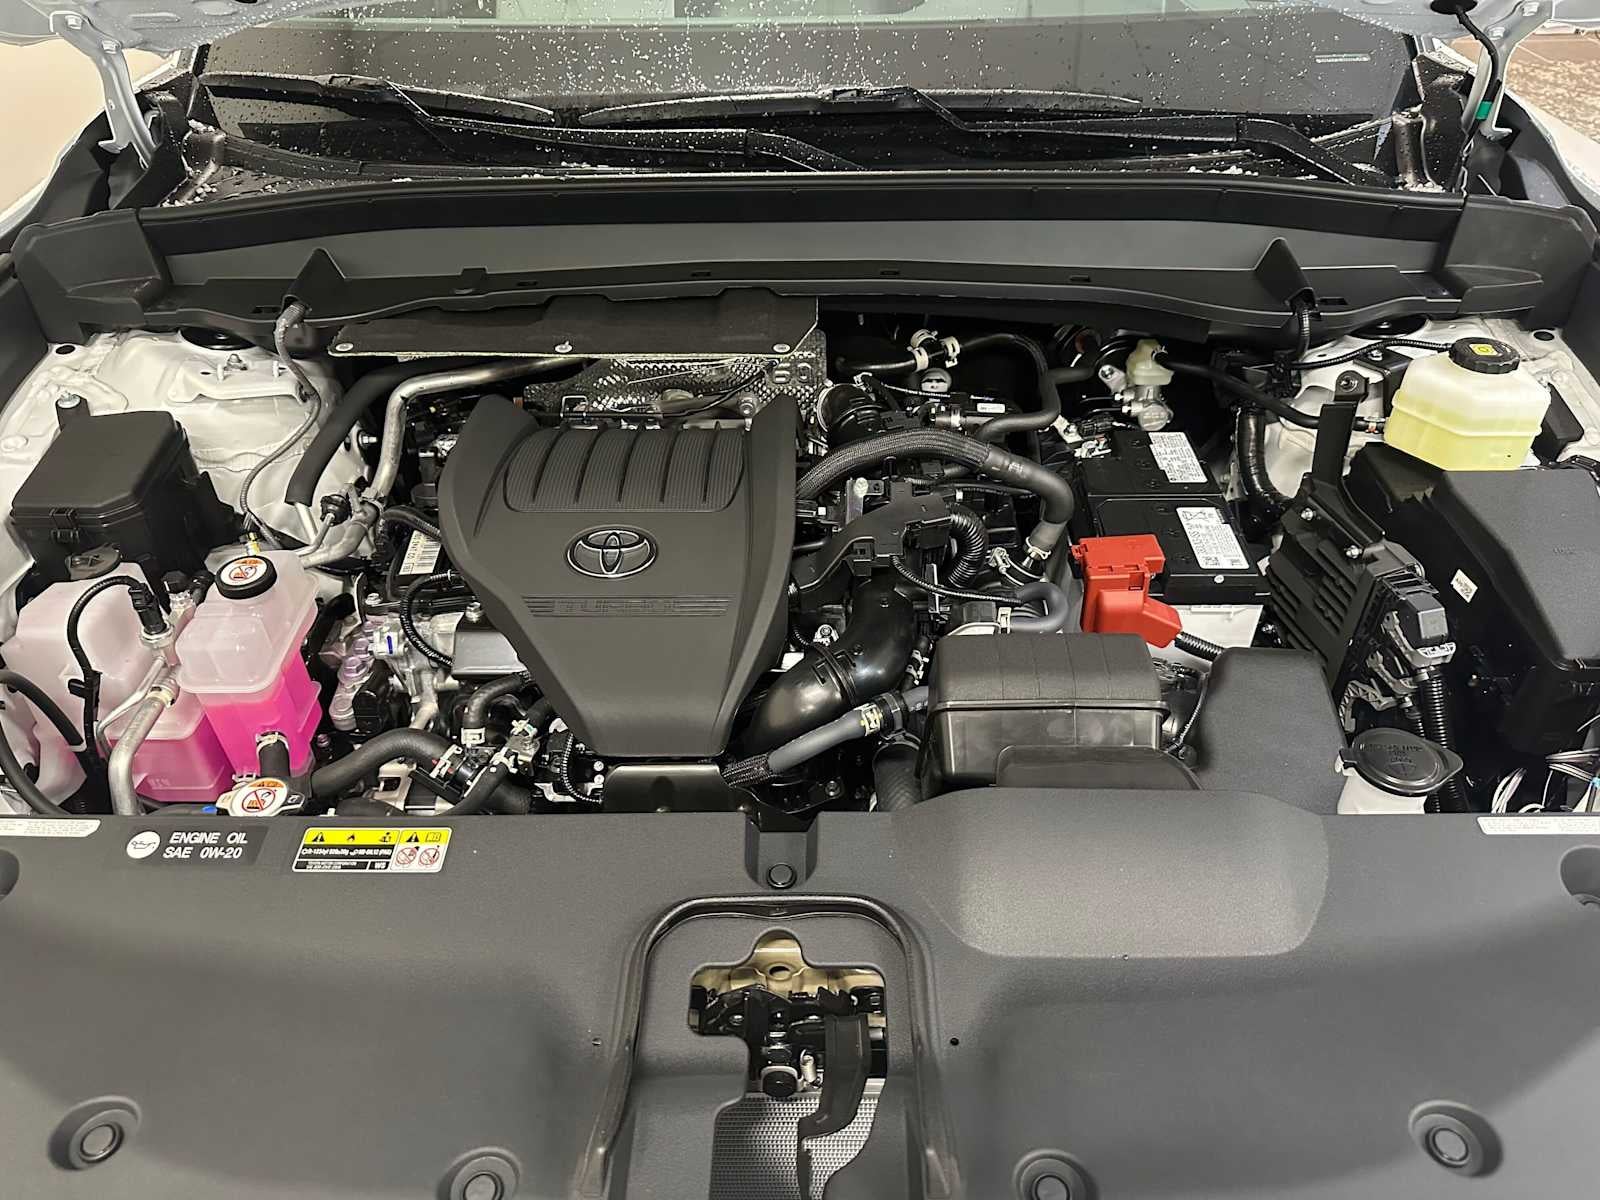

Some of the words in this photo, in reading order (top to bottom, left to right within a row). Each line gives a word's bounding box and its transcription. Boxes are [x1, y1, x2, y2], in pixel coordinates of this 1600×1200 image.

[169, 832, 221, 844] ENGINE
[226, 832, 248, 844] OIL
[163, 846, 194, 859] SAE
[199, 846, 243, 859] 0W-20
